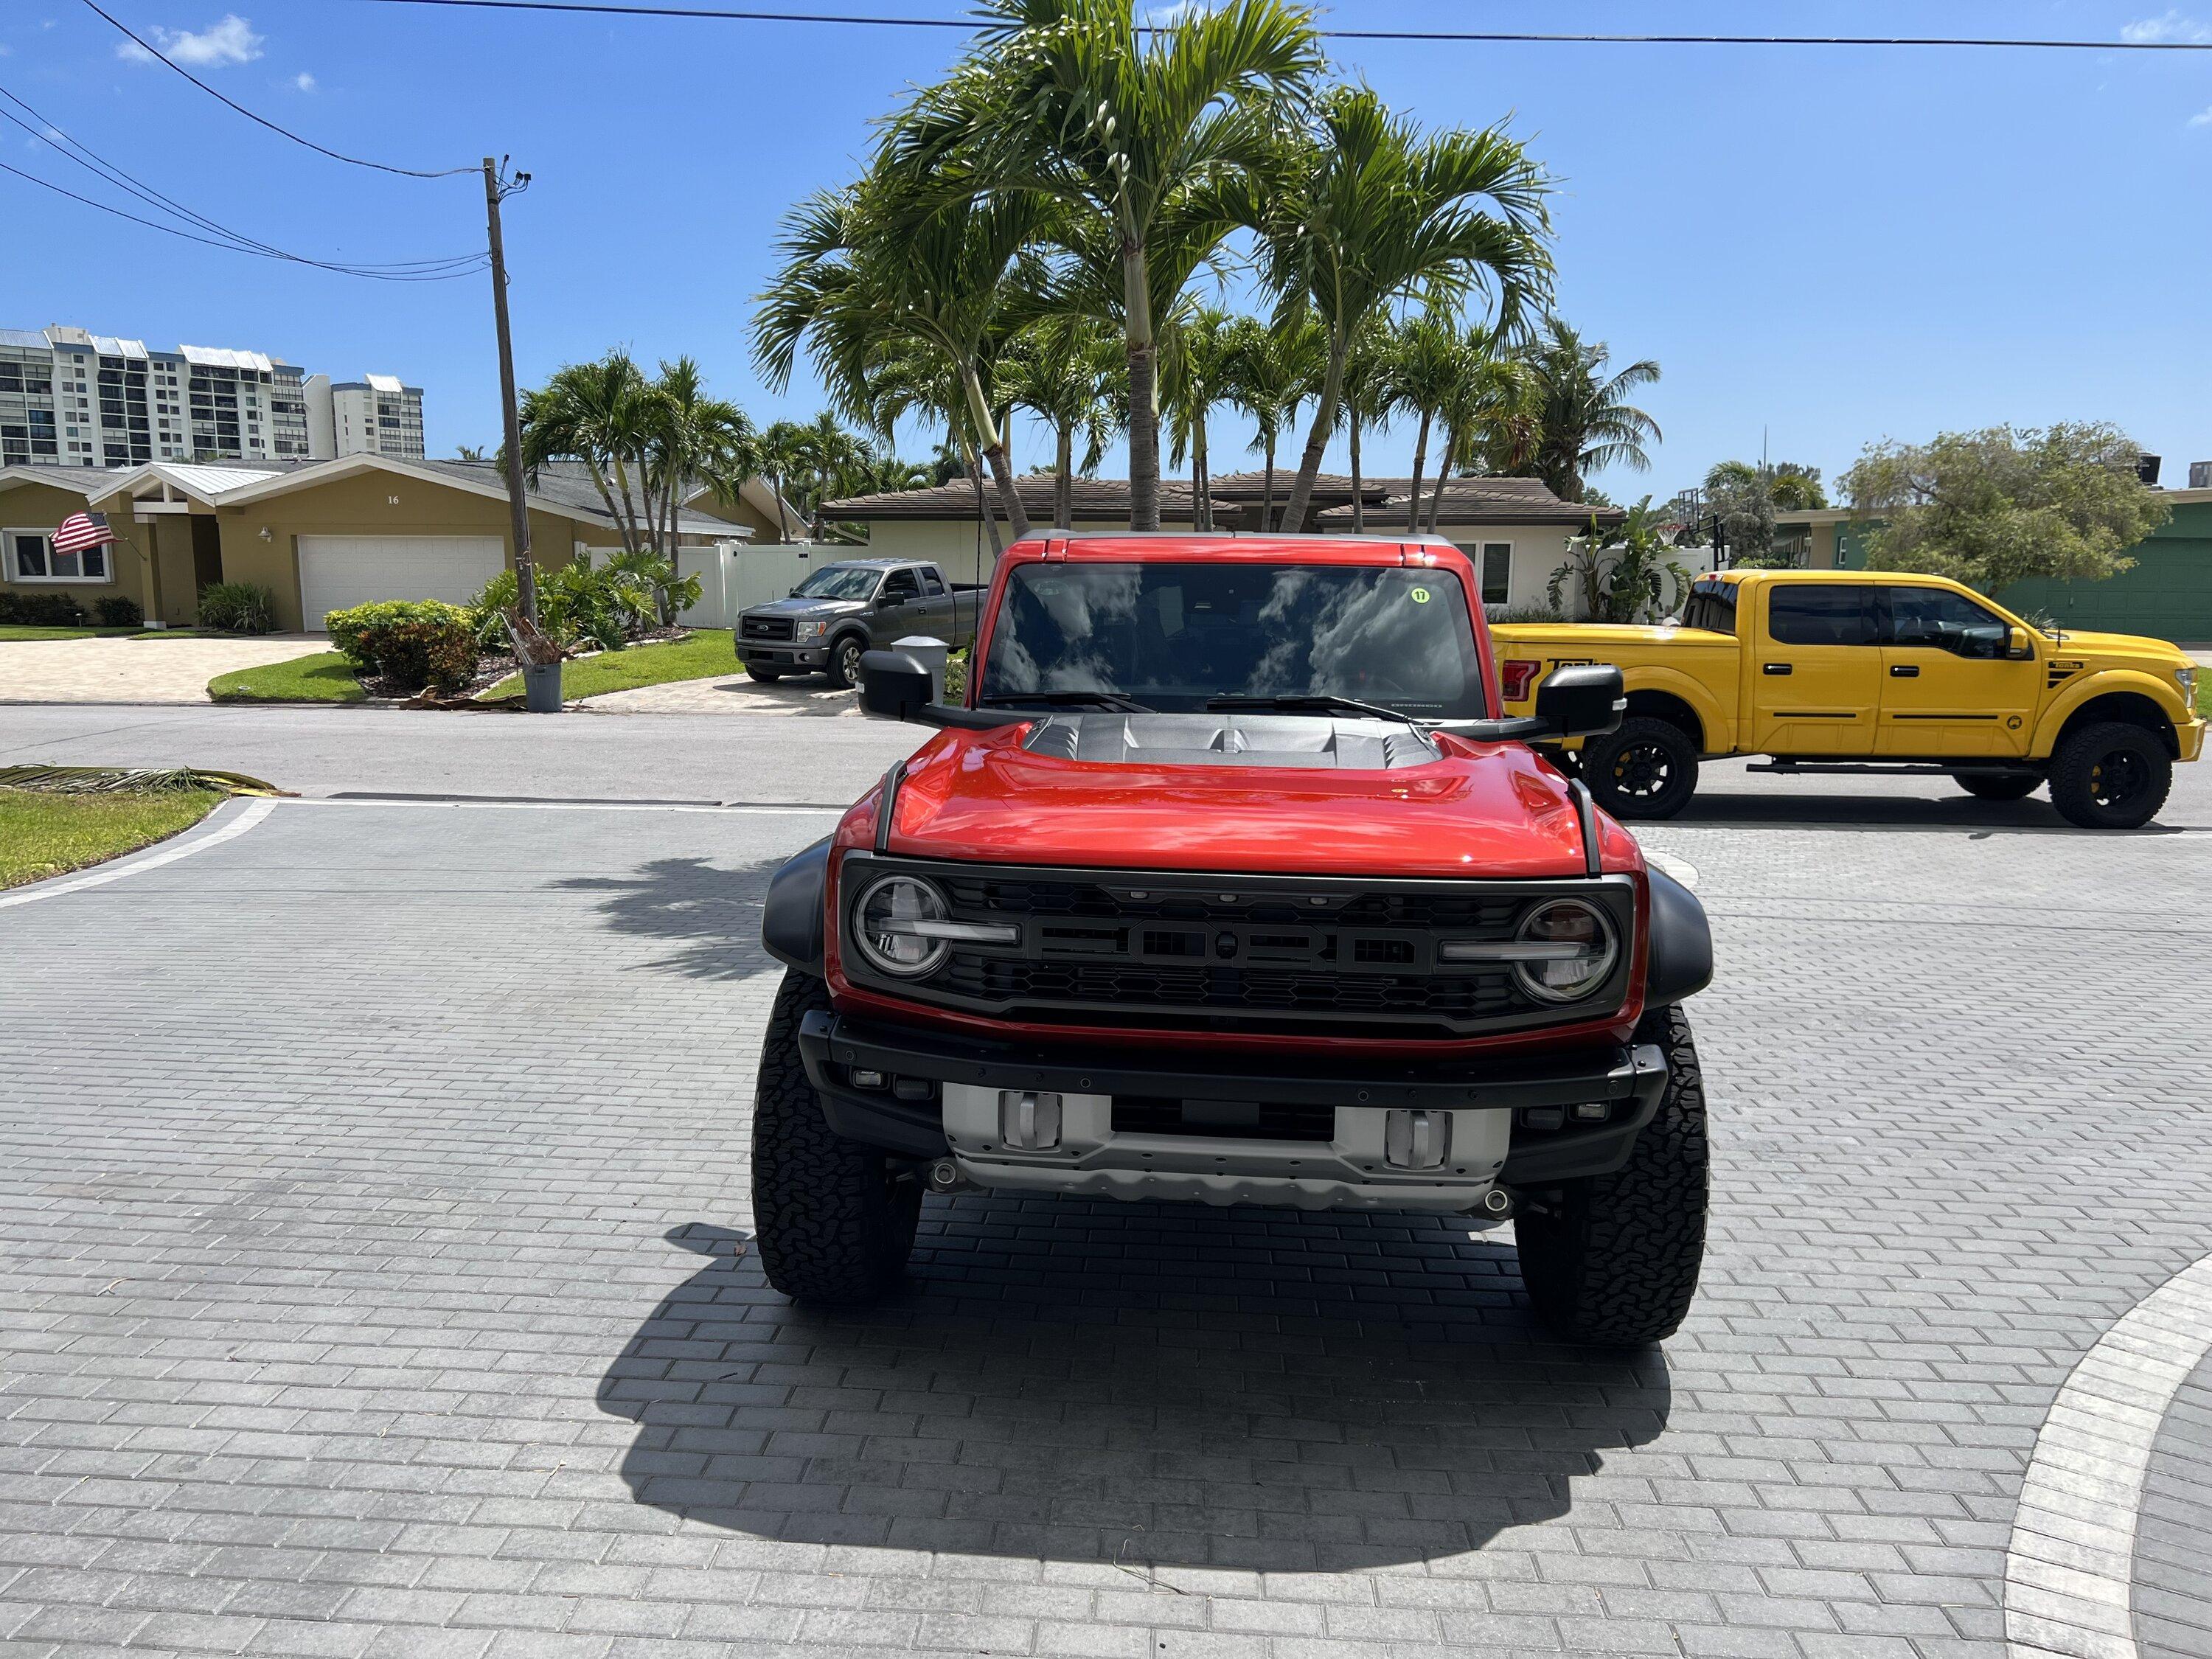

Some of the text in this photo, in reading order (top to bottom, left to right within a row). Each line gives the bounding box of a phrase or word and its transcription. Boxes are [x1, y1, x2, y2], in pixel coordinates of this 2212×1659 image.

[388, 495, 399, 504] 16
[1414, 591, 1425, 600] 17
[1027, 915, 1433, 975] FORD
